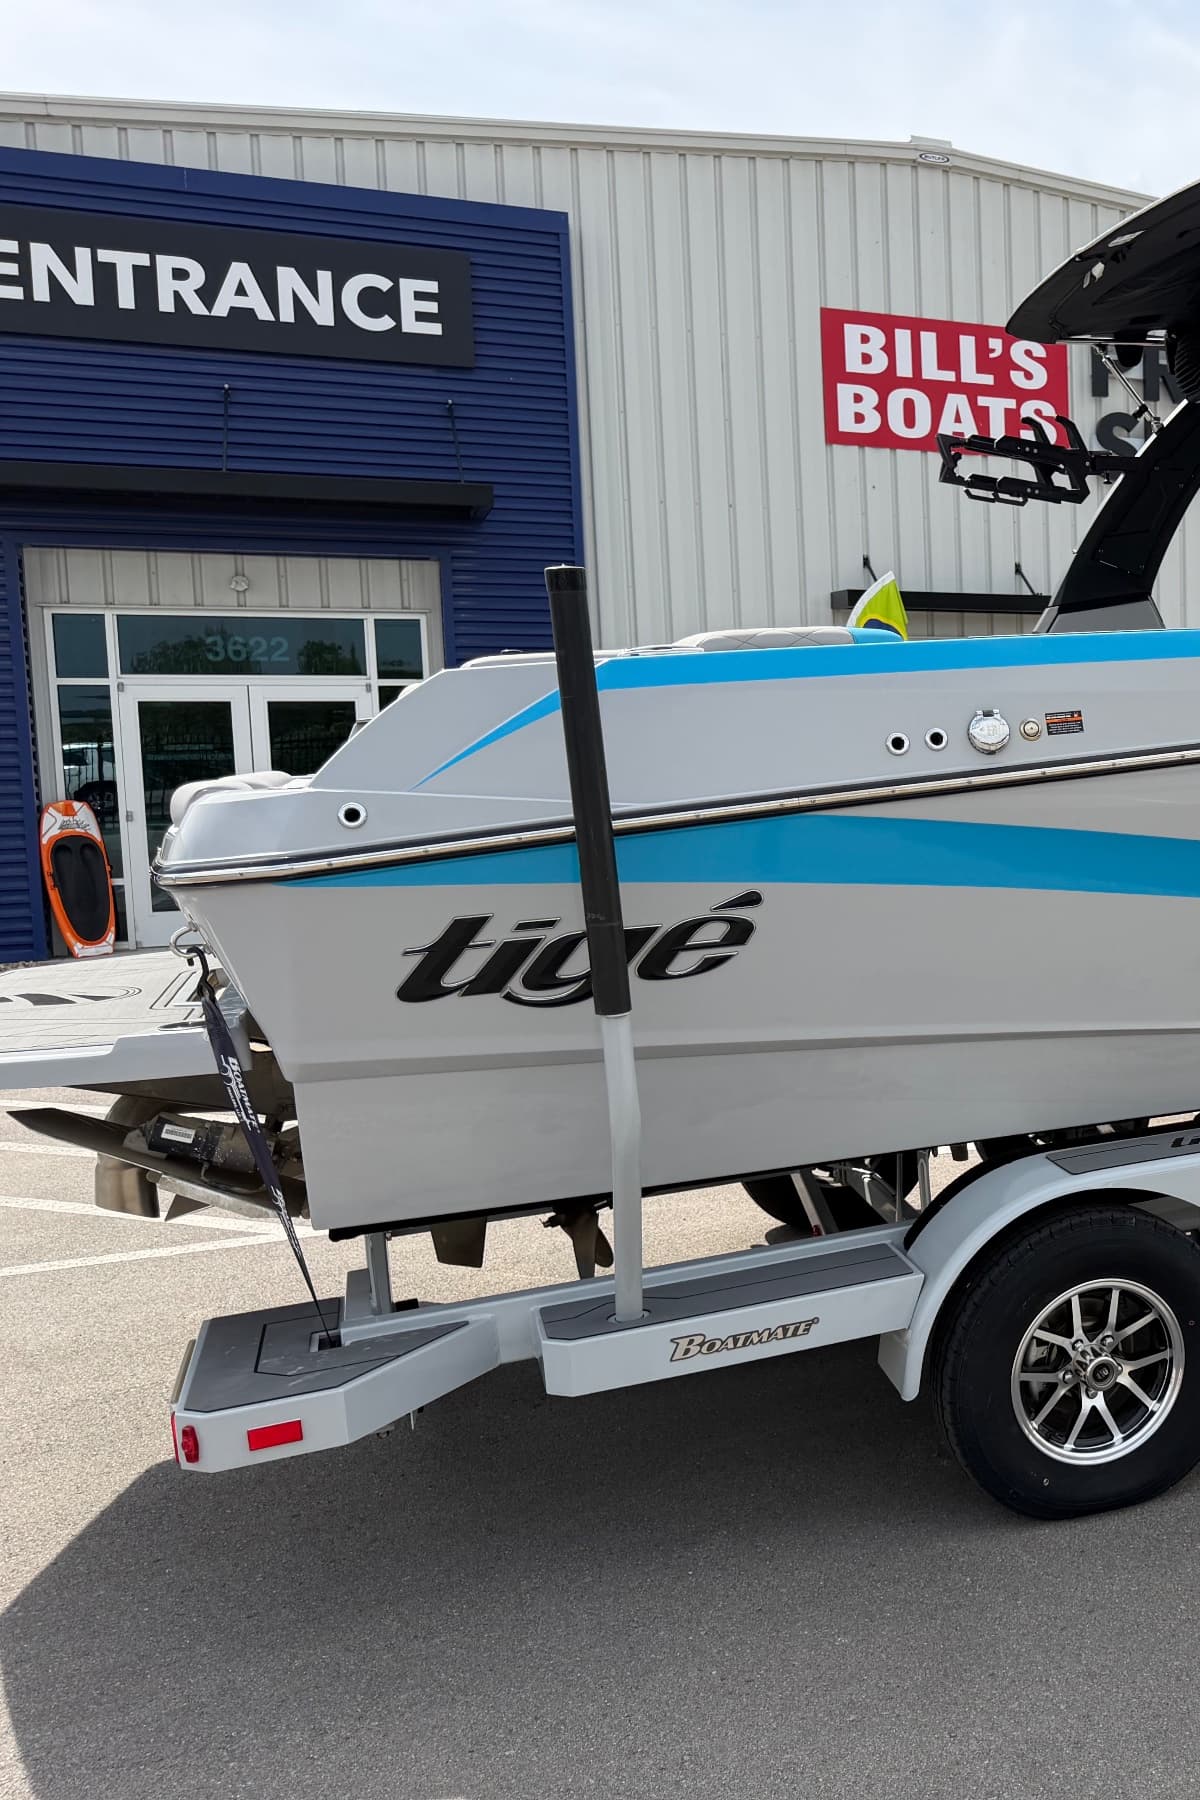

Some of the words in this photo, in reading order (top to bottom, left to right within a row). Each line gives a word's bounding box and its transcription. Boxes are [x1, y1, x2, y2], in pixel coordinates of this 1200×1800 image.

[0, 239, 443, 336] ENTRANCE
[843, 323, 1048, 390] BILL'S
[836, 383, 1058, 446] BOATS
[205, 635, 290, 662] 3622
[396, 889, 764, 1008] tigé
